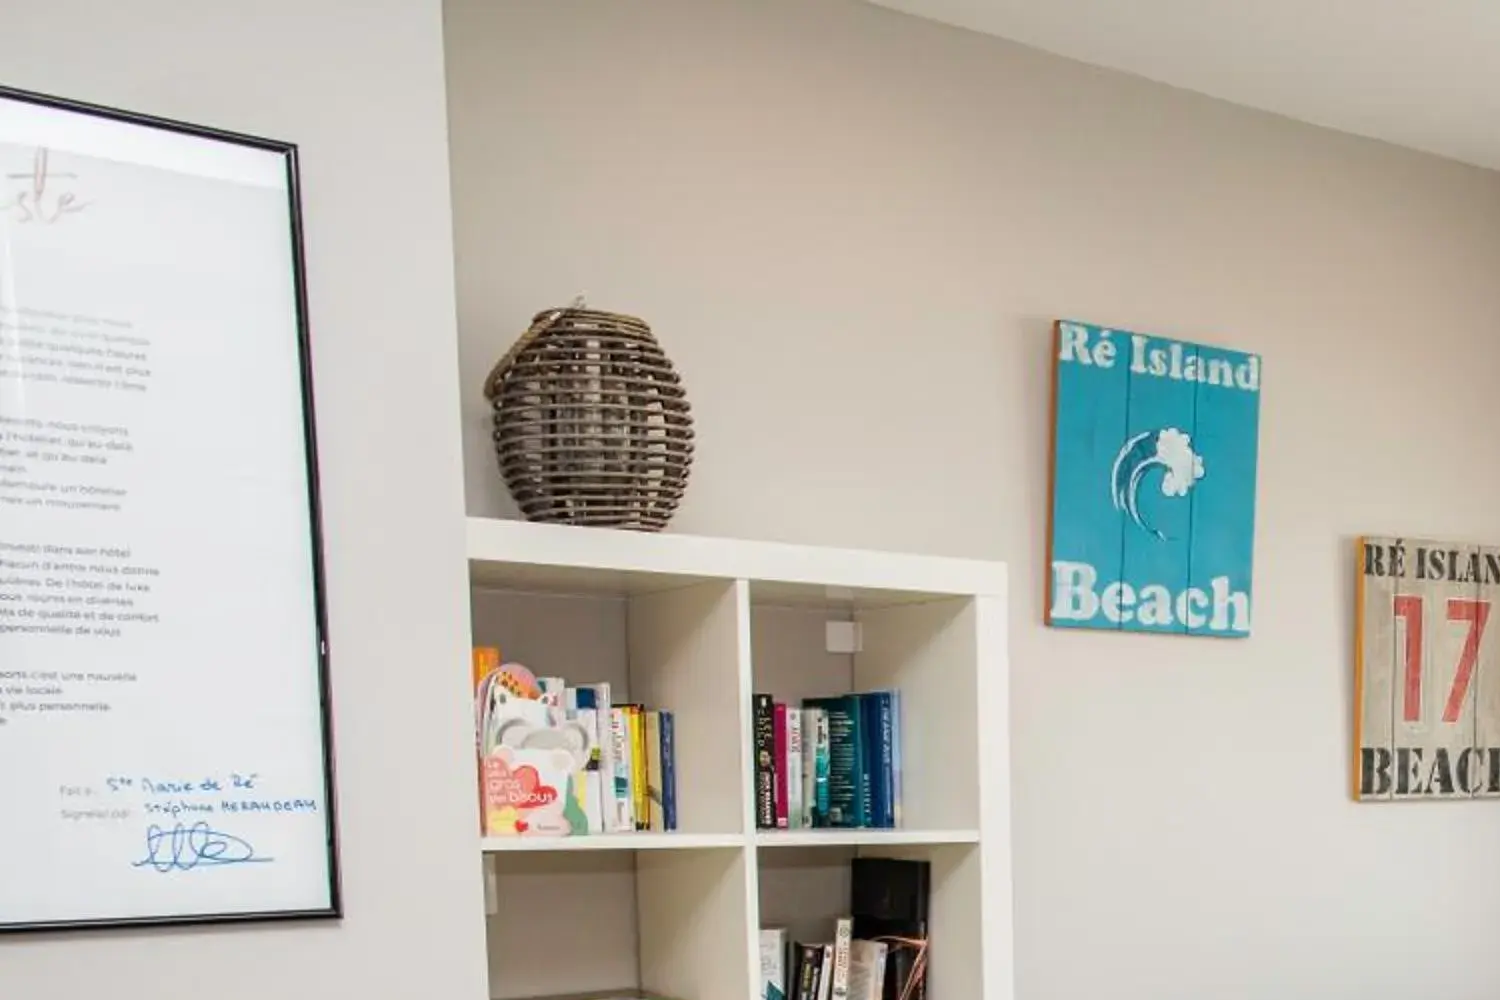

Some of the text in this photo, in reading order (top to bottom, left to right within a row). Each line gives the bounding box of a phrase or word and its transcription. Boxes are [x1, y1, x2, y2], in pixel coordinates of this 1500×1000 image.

[1057, 323, 1260, 391] Ré Island
[1363, 538, 1405, 579] RÉ
[1050, 561, 1251, 633] Beach
[1393, 595, 1491, 724] 17
